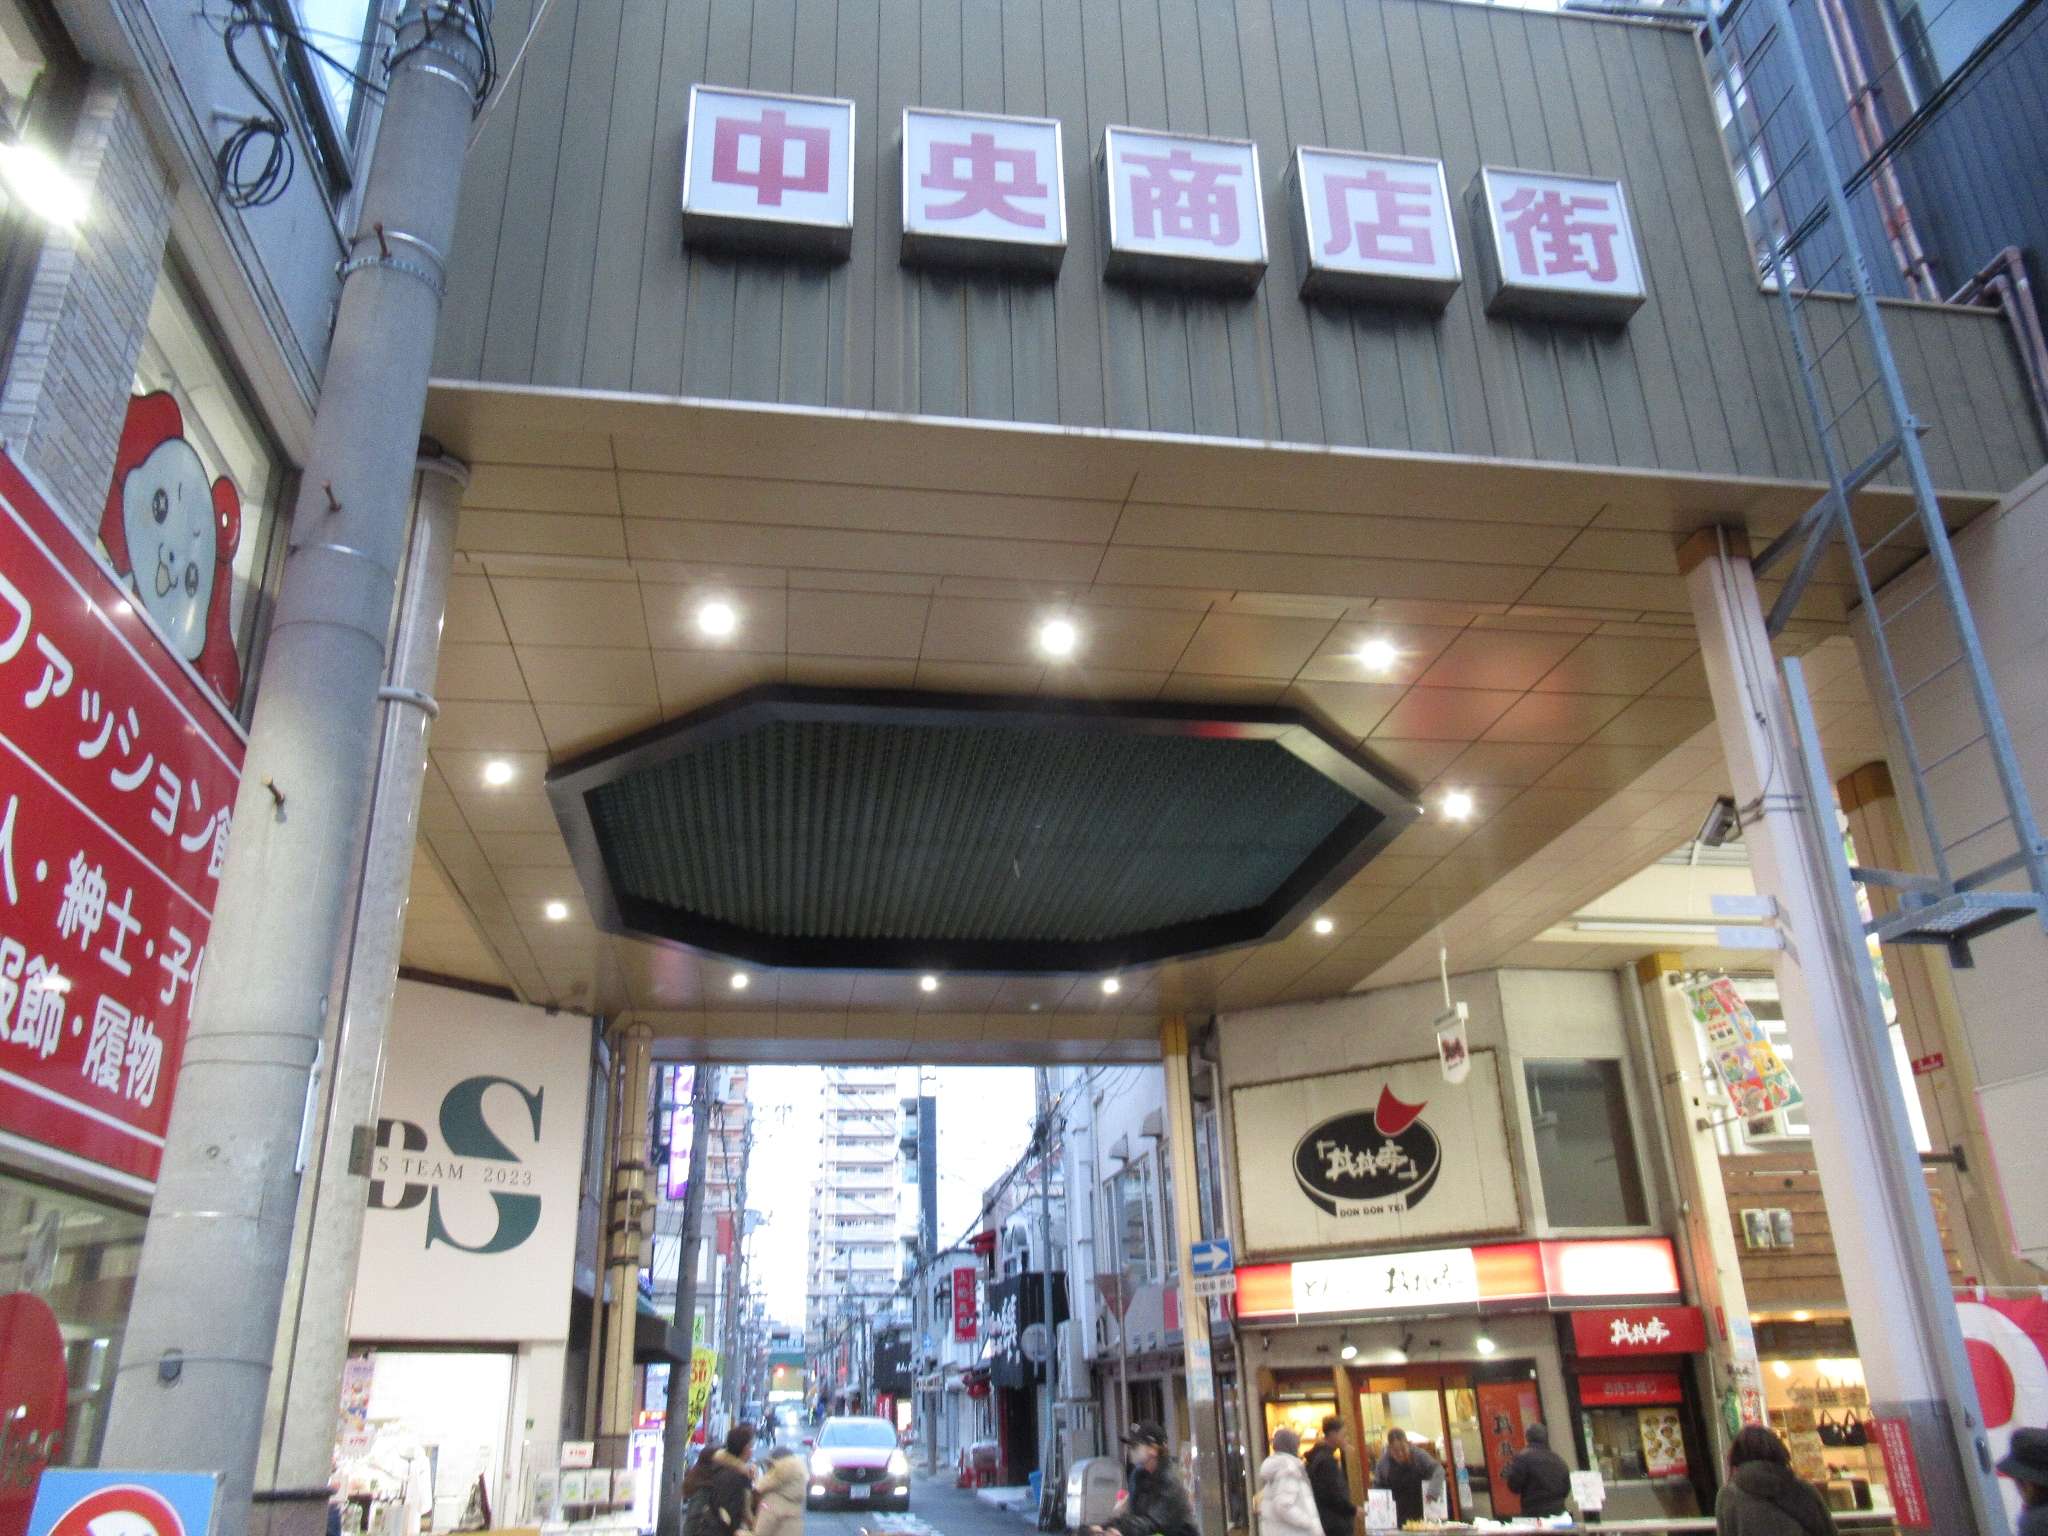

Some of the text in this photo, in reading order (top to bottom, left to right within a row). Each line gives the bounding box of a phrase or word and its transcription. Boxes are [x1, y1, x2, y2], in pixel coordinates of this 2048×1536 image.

[711, 110, 1618, 283] 中央商店街
[402, 1157, 465, 1181] TEAM
[483, 1166, 533, 1187] 2023
[1339, 1207, 1360, 1218] DON
[1363, 1205, 1384, 1215] DON
